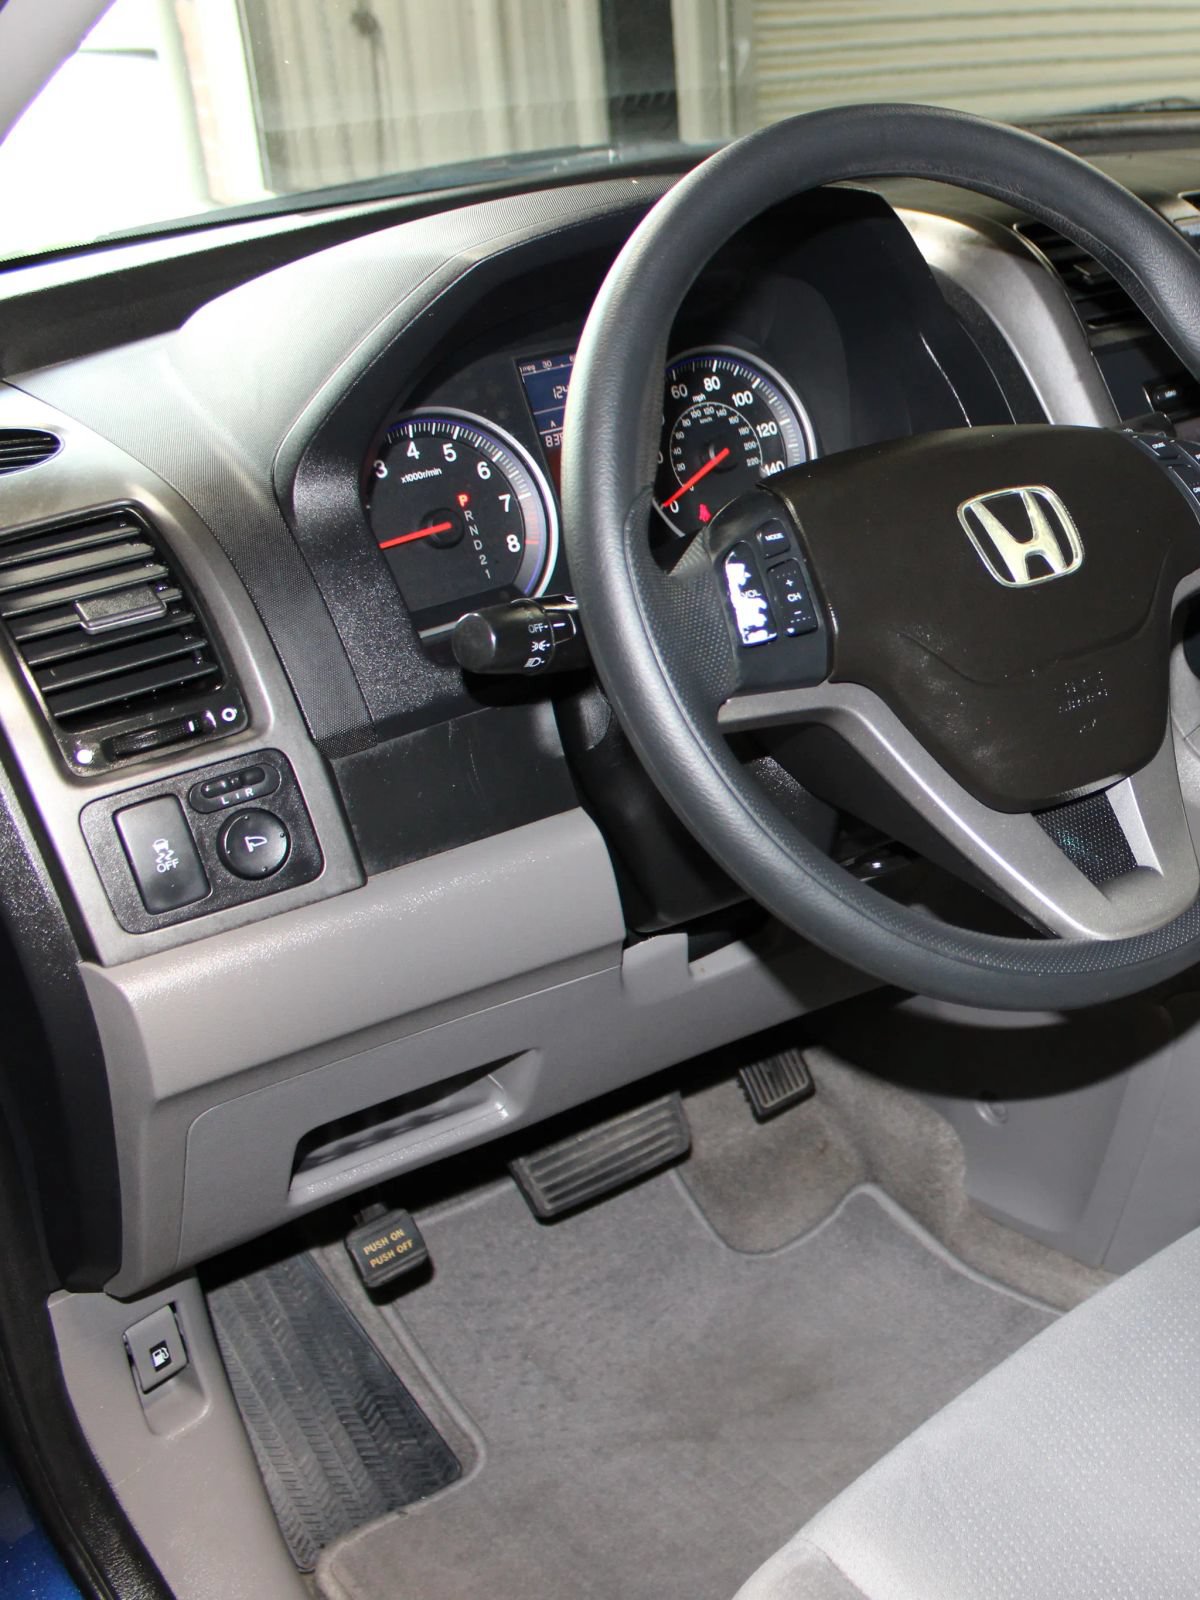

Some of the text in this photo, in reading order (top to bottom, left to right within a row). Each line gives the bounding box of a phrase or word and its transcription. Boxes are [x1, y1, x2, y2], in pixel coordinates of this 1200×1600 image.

[542, 360, 553, 370] 30
[703, 375, 721, 392] 80
[671, 383, 688, 399] 60
[692, 392, 706, 402] mph
[732, 390, 753, 407] 100
[690, 409, 702, 419] 100
[703, 406, 715, 415] 120
[716, 408, 727, 417] 140
[549, 420, 557, 429] A
[681, 418, 692, 427] 80
[675, 431, 685, 440] 60
[738, 426, 749, 436] 180
[756, 421, 778, 438] 120
[406, 441, 420, 460] 4
[443, 443, 457, 462] 5
[672, 447, 682, 456] 40
[743, 441, 758, 451] 200
[676, 462, 686, 472] 20
[746, 457, 760, 467] 220
[763, 460, 785, 477] 140
[373, 459, 388, 479] 3
[400, 467, 442, 483] x1000r/min
[477, 461, 491, 480] 6
[498, 493, 511, 512] 7
[669, 500, 679, 513] 0
[458, 495, 491, 579] P R N D 2 1
[506, 534, 521, 553] 8
[787, 591, 802, 602] CH
[528, 623, 543, 633] OFF
[221, 788, 254, 805] L R
[157, 860, 179, 873] OFF
[363, 1228, 405, 1255] PUSH ON
[370, 1239, 412, 1267] PUSH OFF
